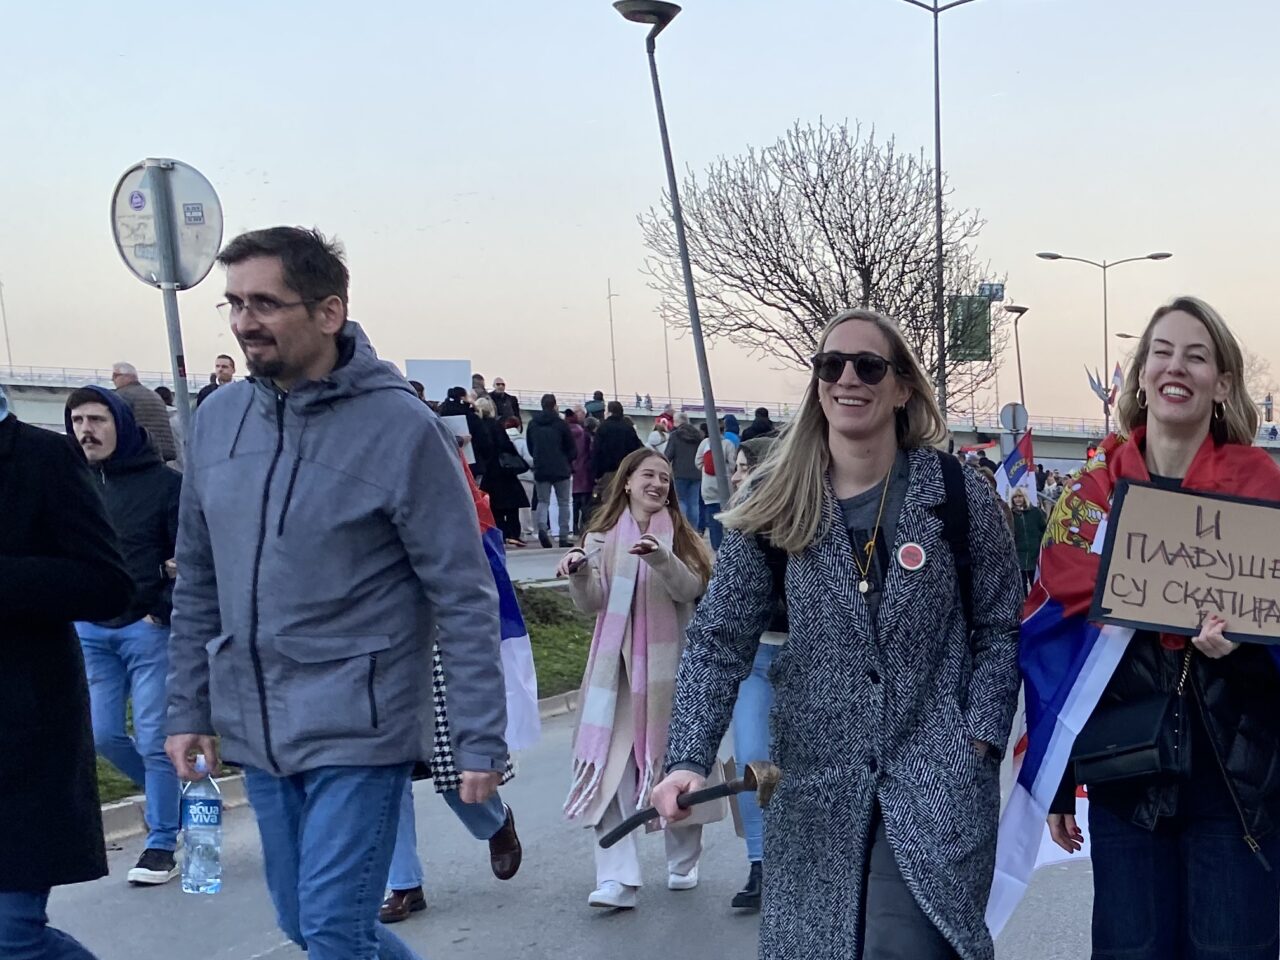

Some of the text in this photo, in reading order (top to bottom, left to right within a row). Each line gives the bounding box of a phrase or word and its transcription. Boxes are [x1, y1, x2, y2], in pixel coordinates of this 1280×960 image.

[1196, 505, 1221, 540] И
[1111, 573, 1147, 607] СУ
[191, 814, 218, 823] viva
